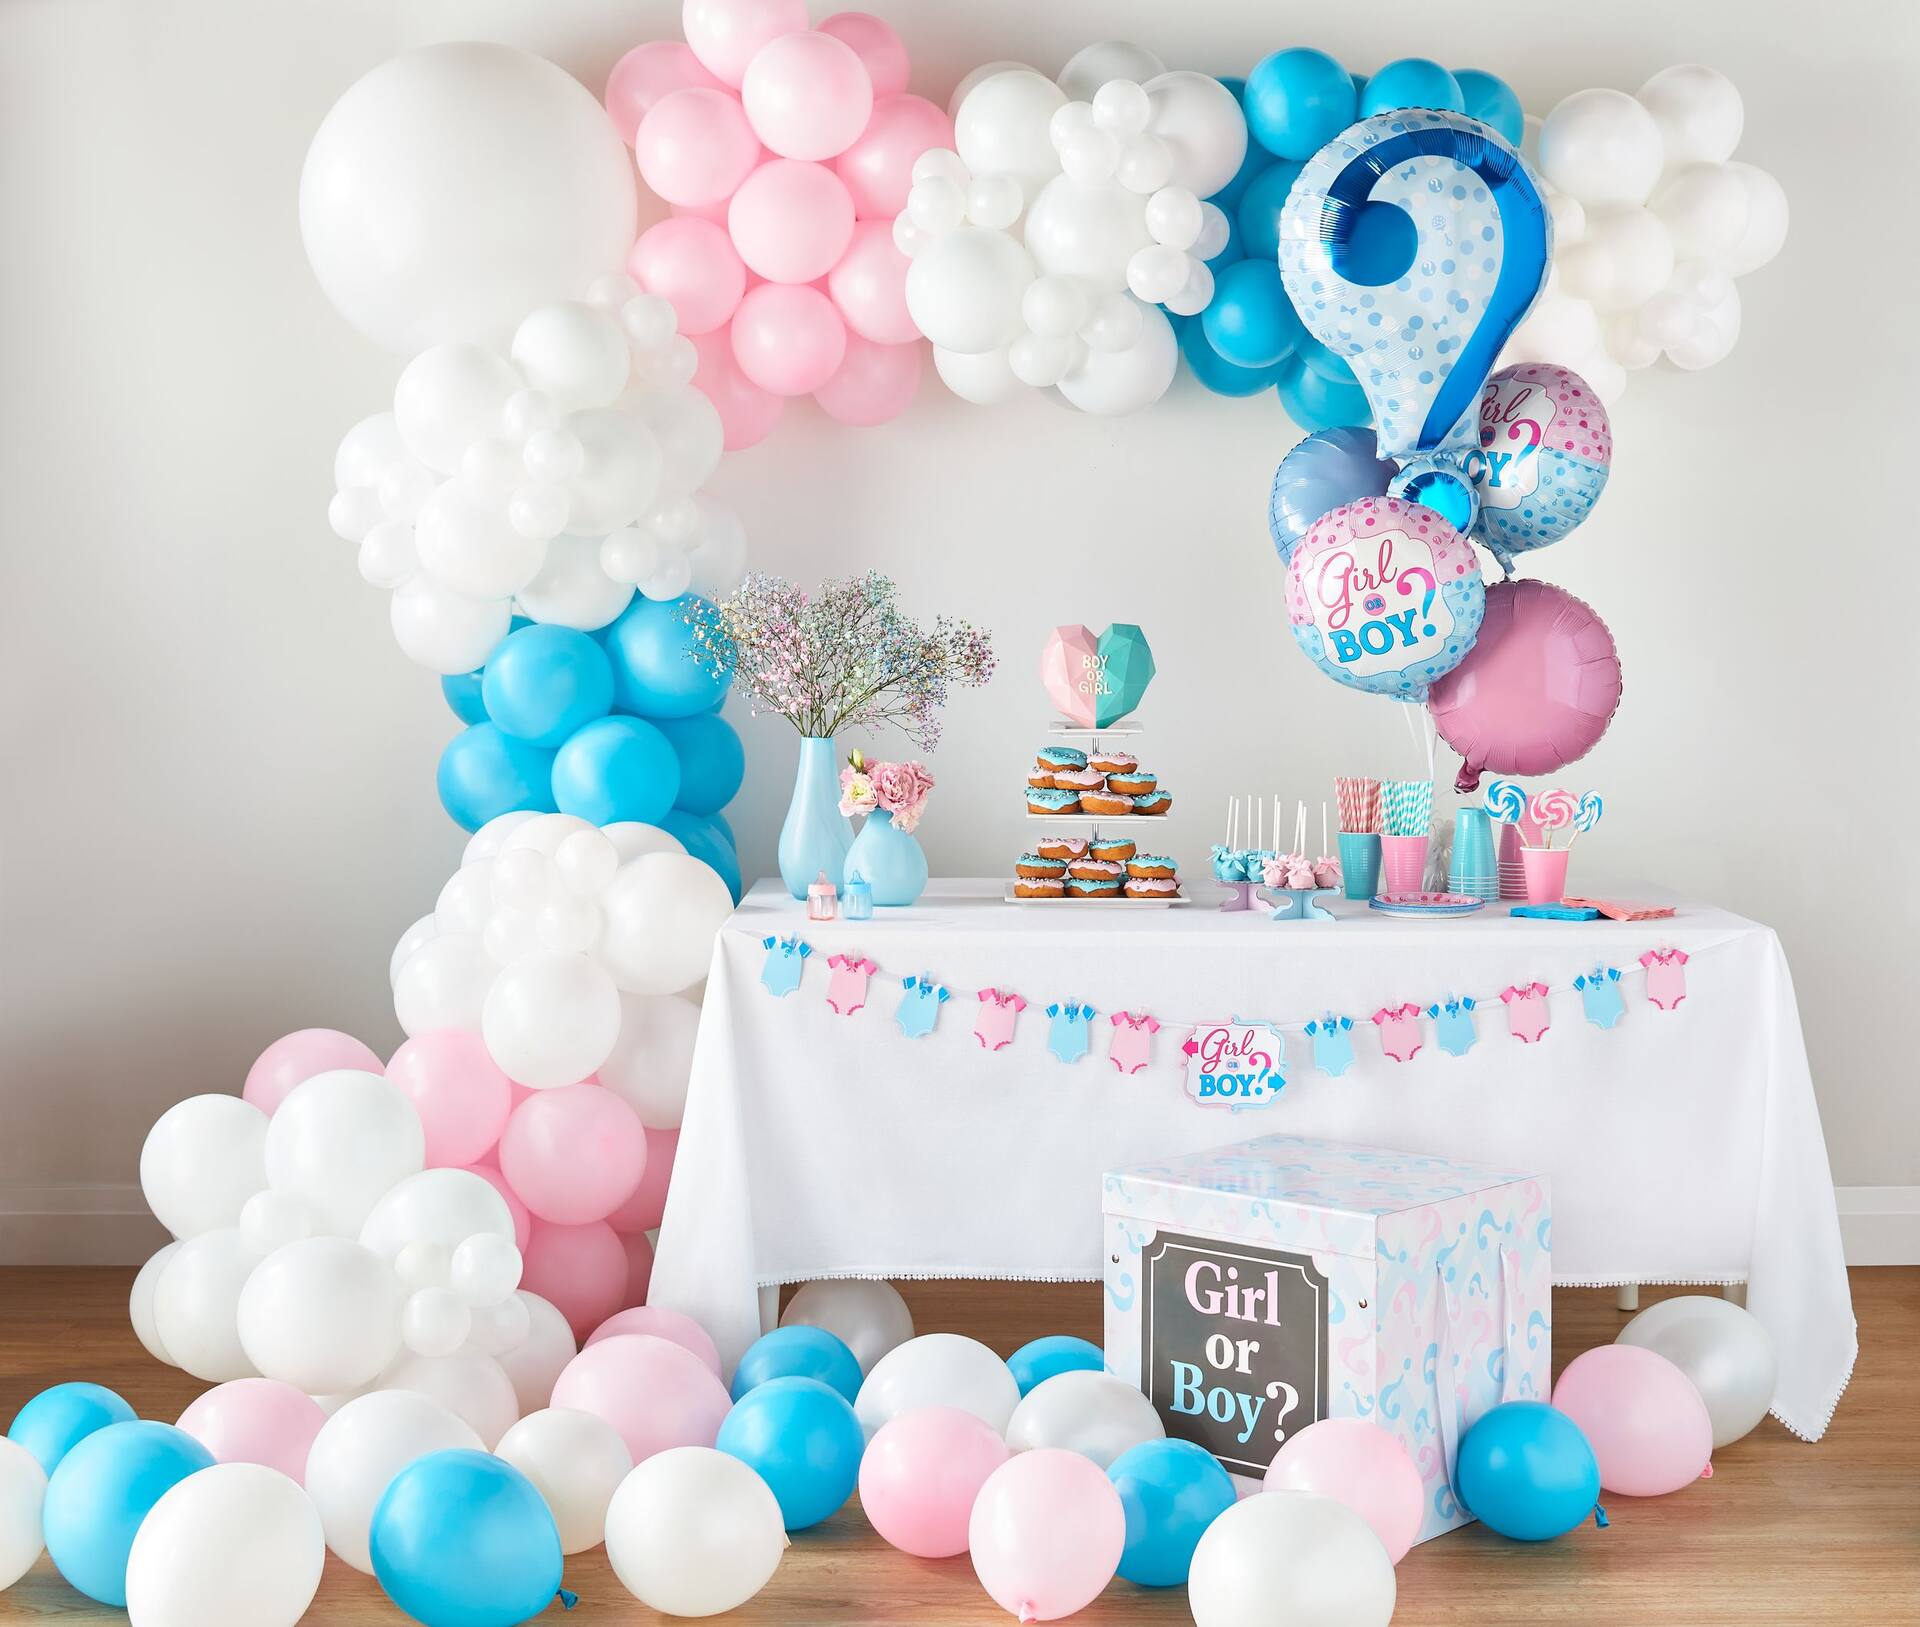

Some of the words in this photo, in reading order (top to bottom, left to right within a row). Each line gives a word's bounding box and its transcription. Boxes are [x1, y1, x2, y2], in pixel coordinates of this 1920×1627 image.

[1317, 539, 1398, 630] Girl
[1365, 597, 1384, 611] OR
[1328, 567, 1438, 664] BOY?
[1082, 654, 1109, 670] BOY
[1086, 670, 1104, 682] OR
[1078, 681, 1113, 695] GIRL
[1198, 1051, 1272, 1097] BOY?
[1200, 1028, 1255, 1074] Girl
[1184, 1260, 1281, 1327] Girl
[1205, 1333, 1260, 1375] or
[1169, 1359, 1300, 1444] Boy?
